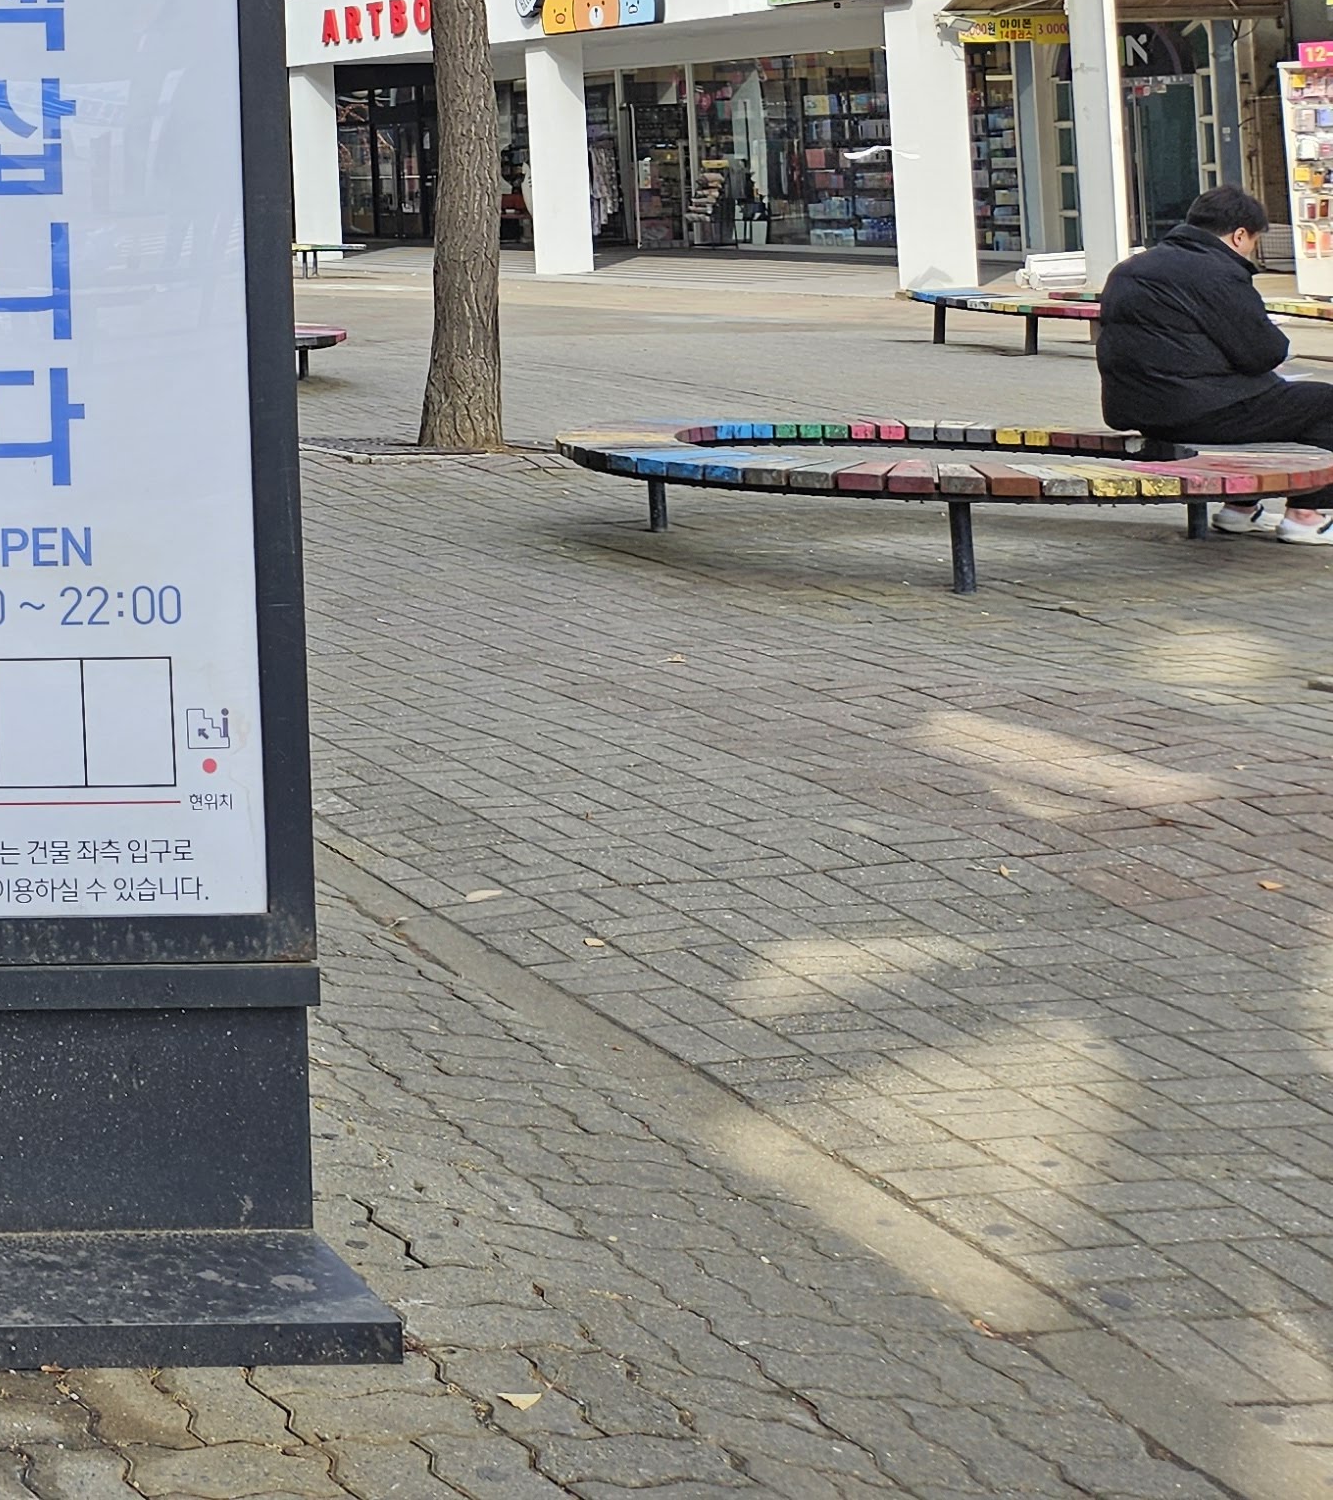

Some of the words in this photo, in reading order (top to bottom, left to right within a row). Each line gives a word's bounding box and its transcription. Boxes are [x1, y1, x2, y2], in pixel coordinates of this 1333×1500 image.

[59, 585, 183, 627] 22:00
[189, 793, 234, 812] 현위치
[27, 840, 71, 866] 건물
[76, 840, 122, 864] 좌측
[128, 839, 194, 864] 입구로
[85, 878, 107, 902] 수
[115, 876, 210, 903] 있습니다.
